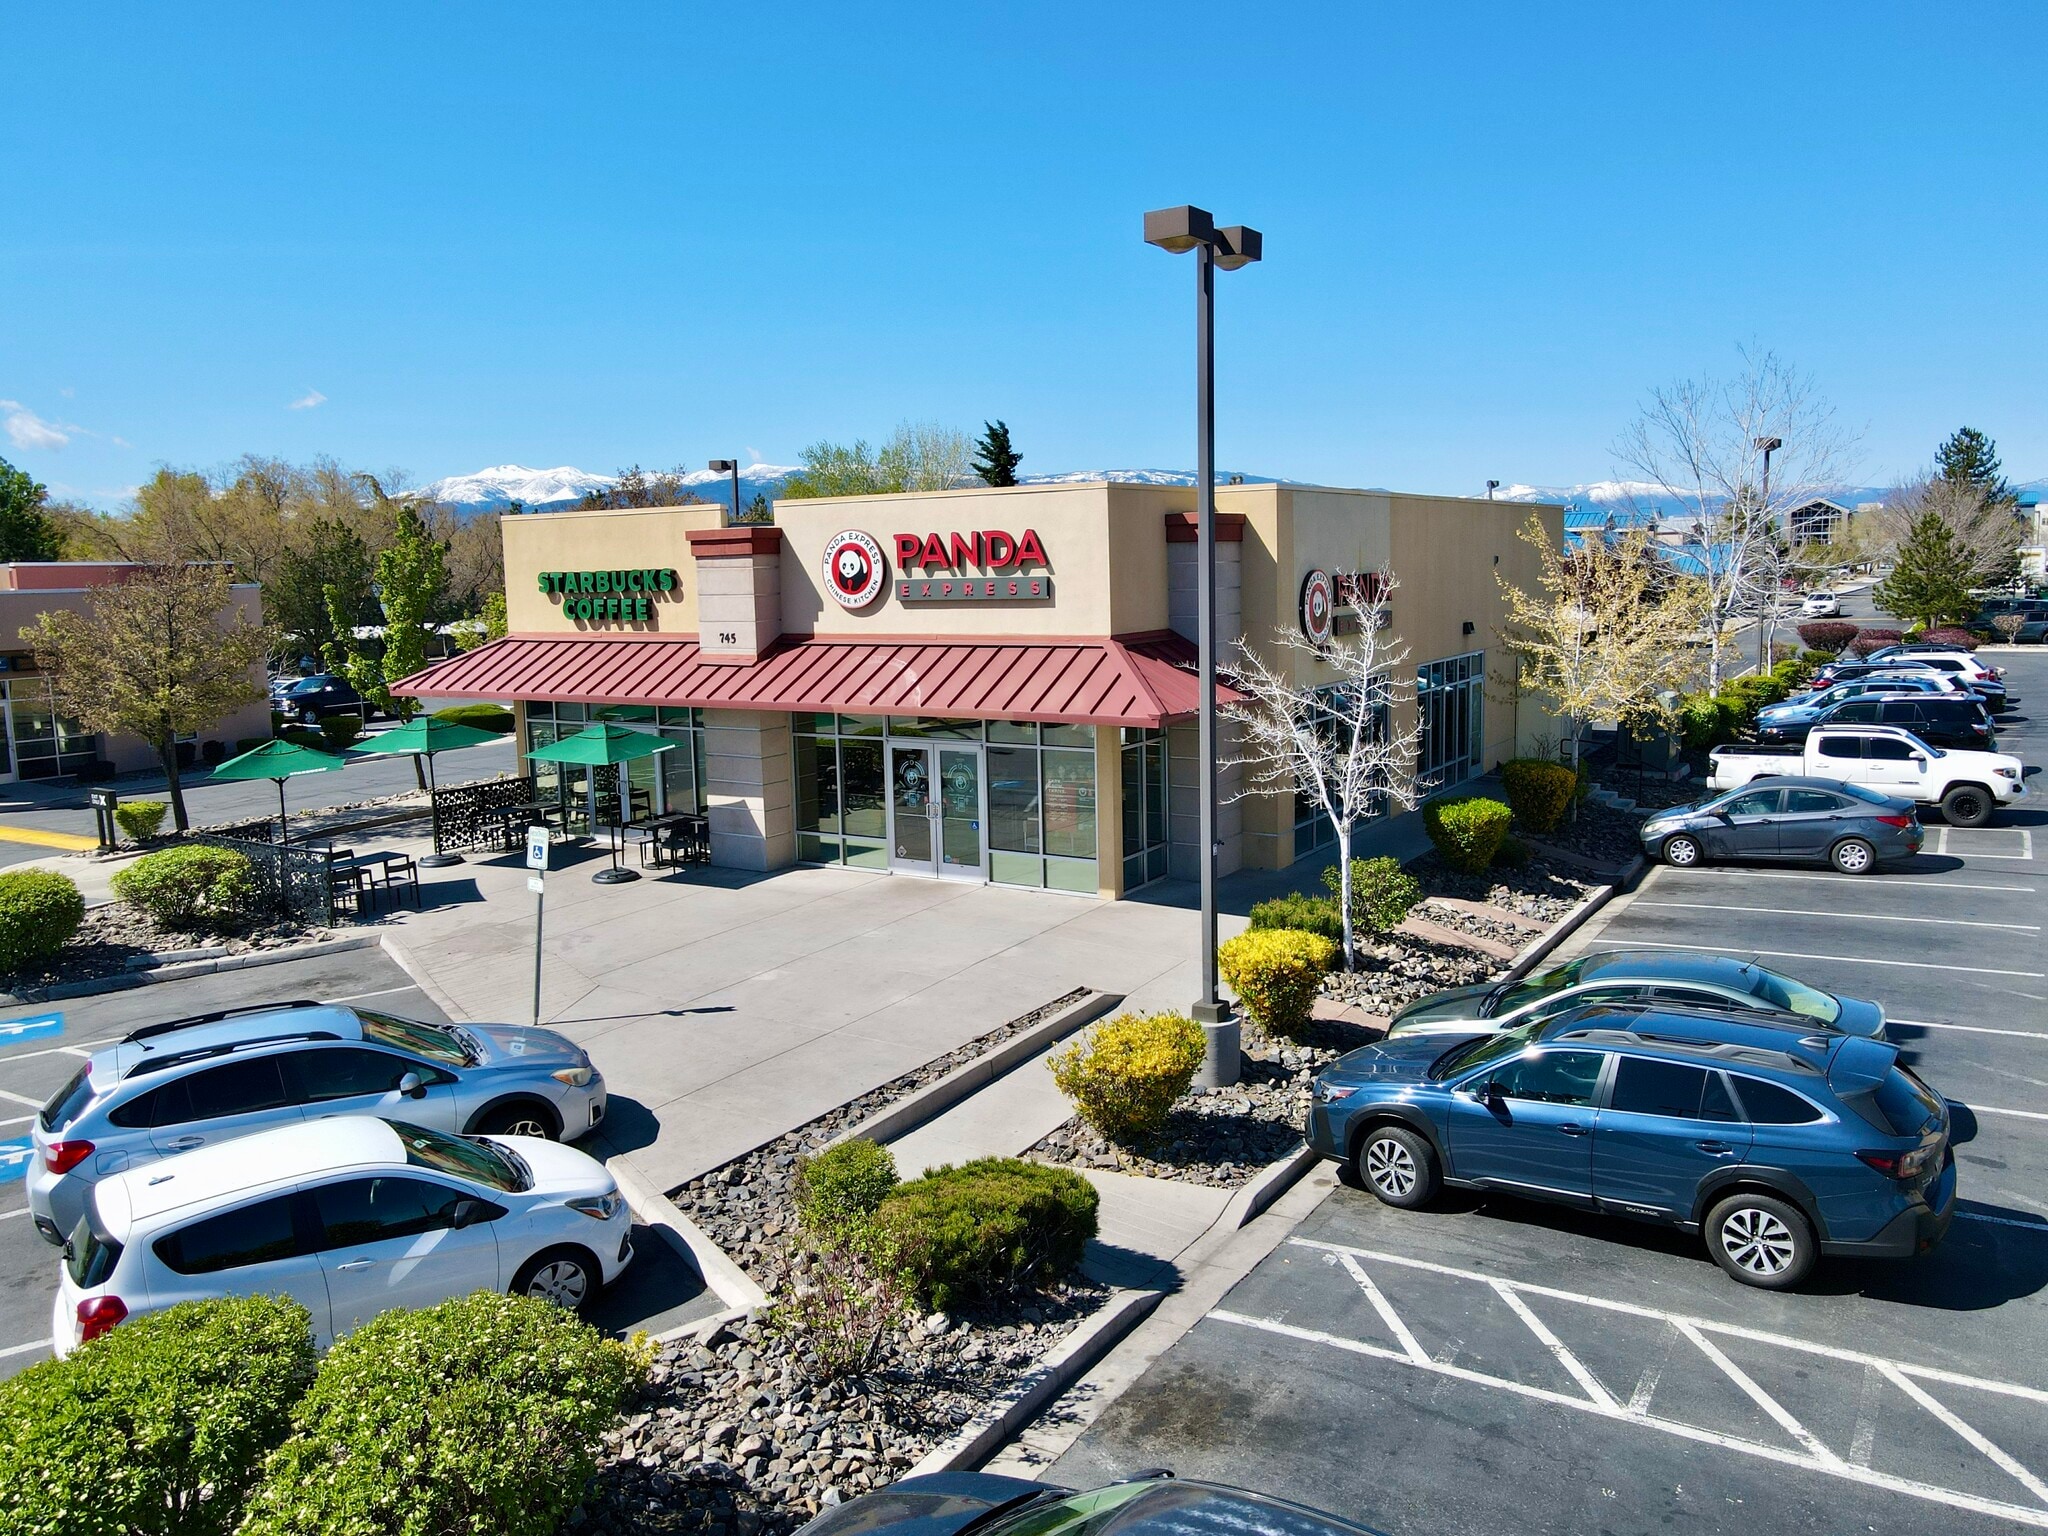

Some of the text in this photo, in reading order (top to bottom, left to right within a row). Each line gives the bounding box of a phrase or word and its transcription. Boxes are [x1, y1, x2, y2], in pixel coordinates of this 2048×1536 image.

[824, 532, 880, 565] PANDA EXPRESS
[893, 529, 1047, 569] PANDA
[537, 568, 673, 593] STARBUCKS
[826, 578, 879, 604] CHINESE KITCHEN
[900, 581, 1041, 597] EXPRESS
[563, 598, 648, 620] COFFEE
[719, 632, 737, 645] 745
